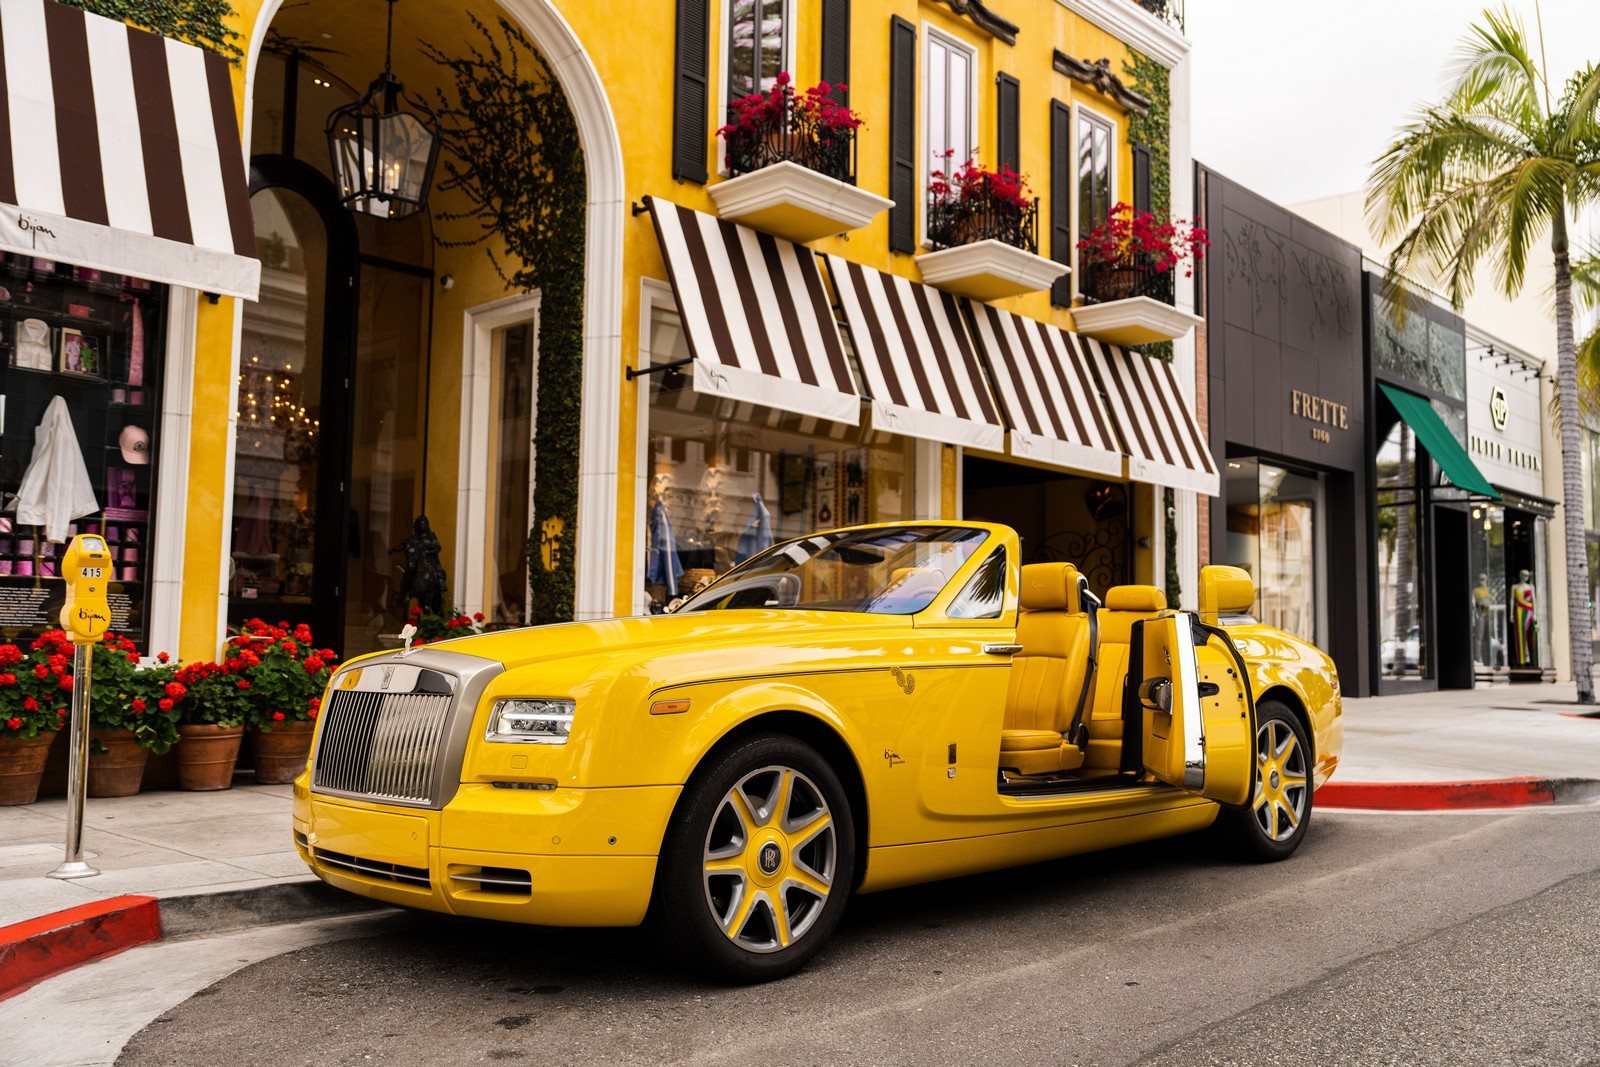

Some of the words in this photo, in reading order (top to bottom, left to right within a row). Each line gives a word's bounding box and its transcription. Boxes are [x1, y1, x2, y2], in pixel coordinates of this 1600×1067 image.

[18, 213, 56, 250] bijan
[1292, 389, 1349, 430] FRETTE
[82, 567, 101, 578] 415
[79, 608, 106, 633] bijan
